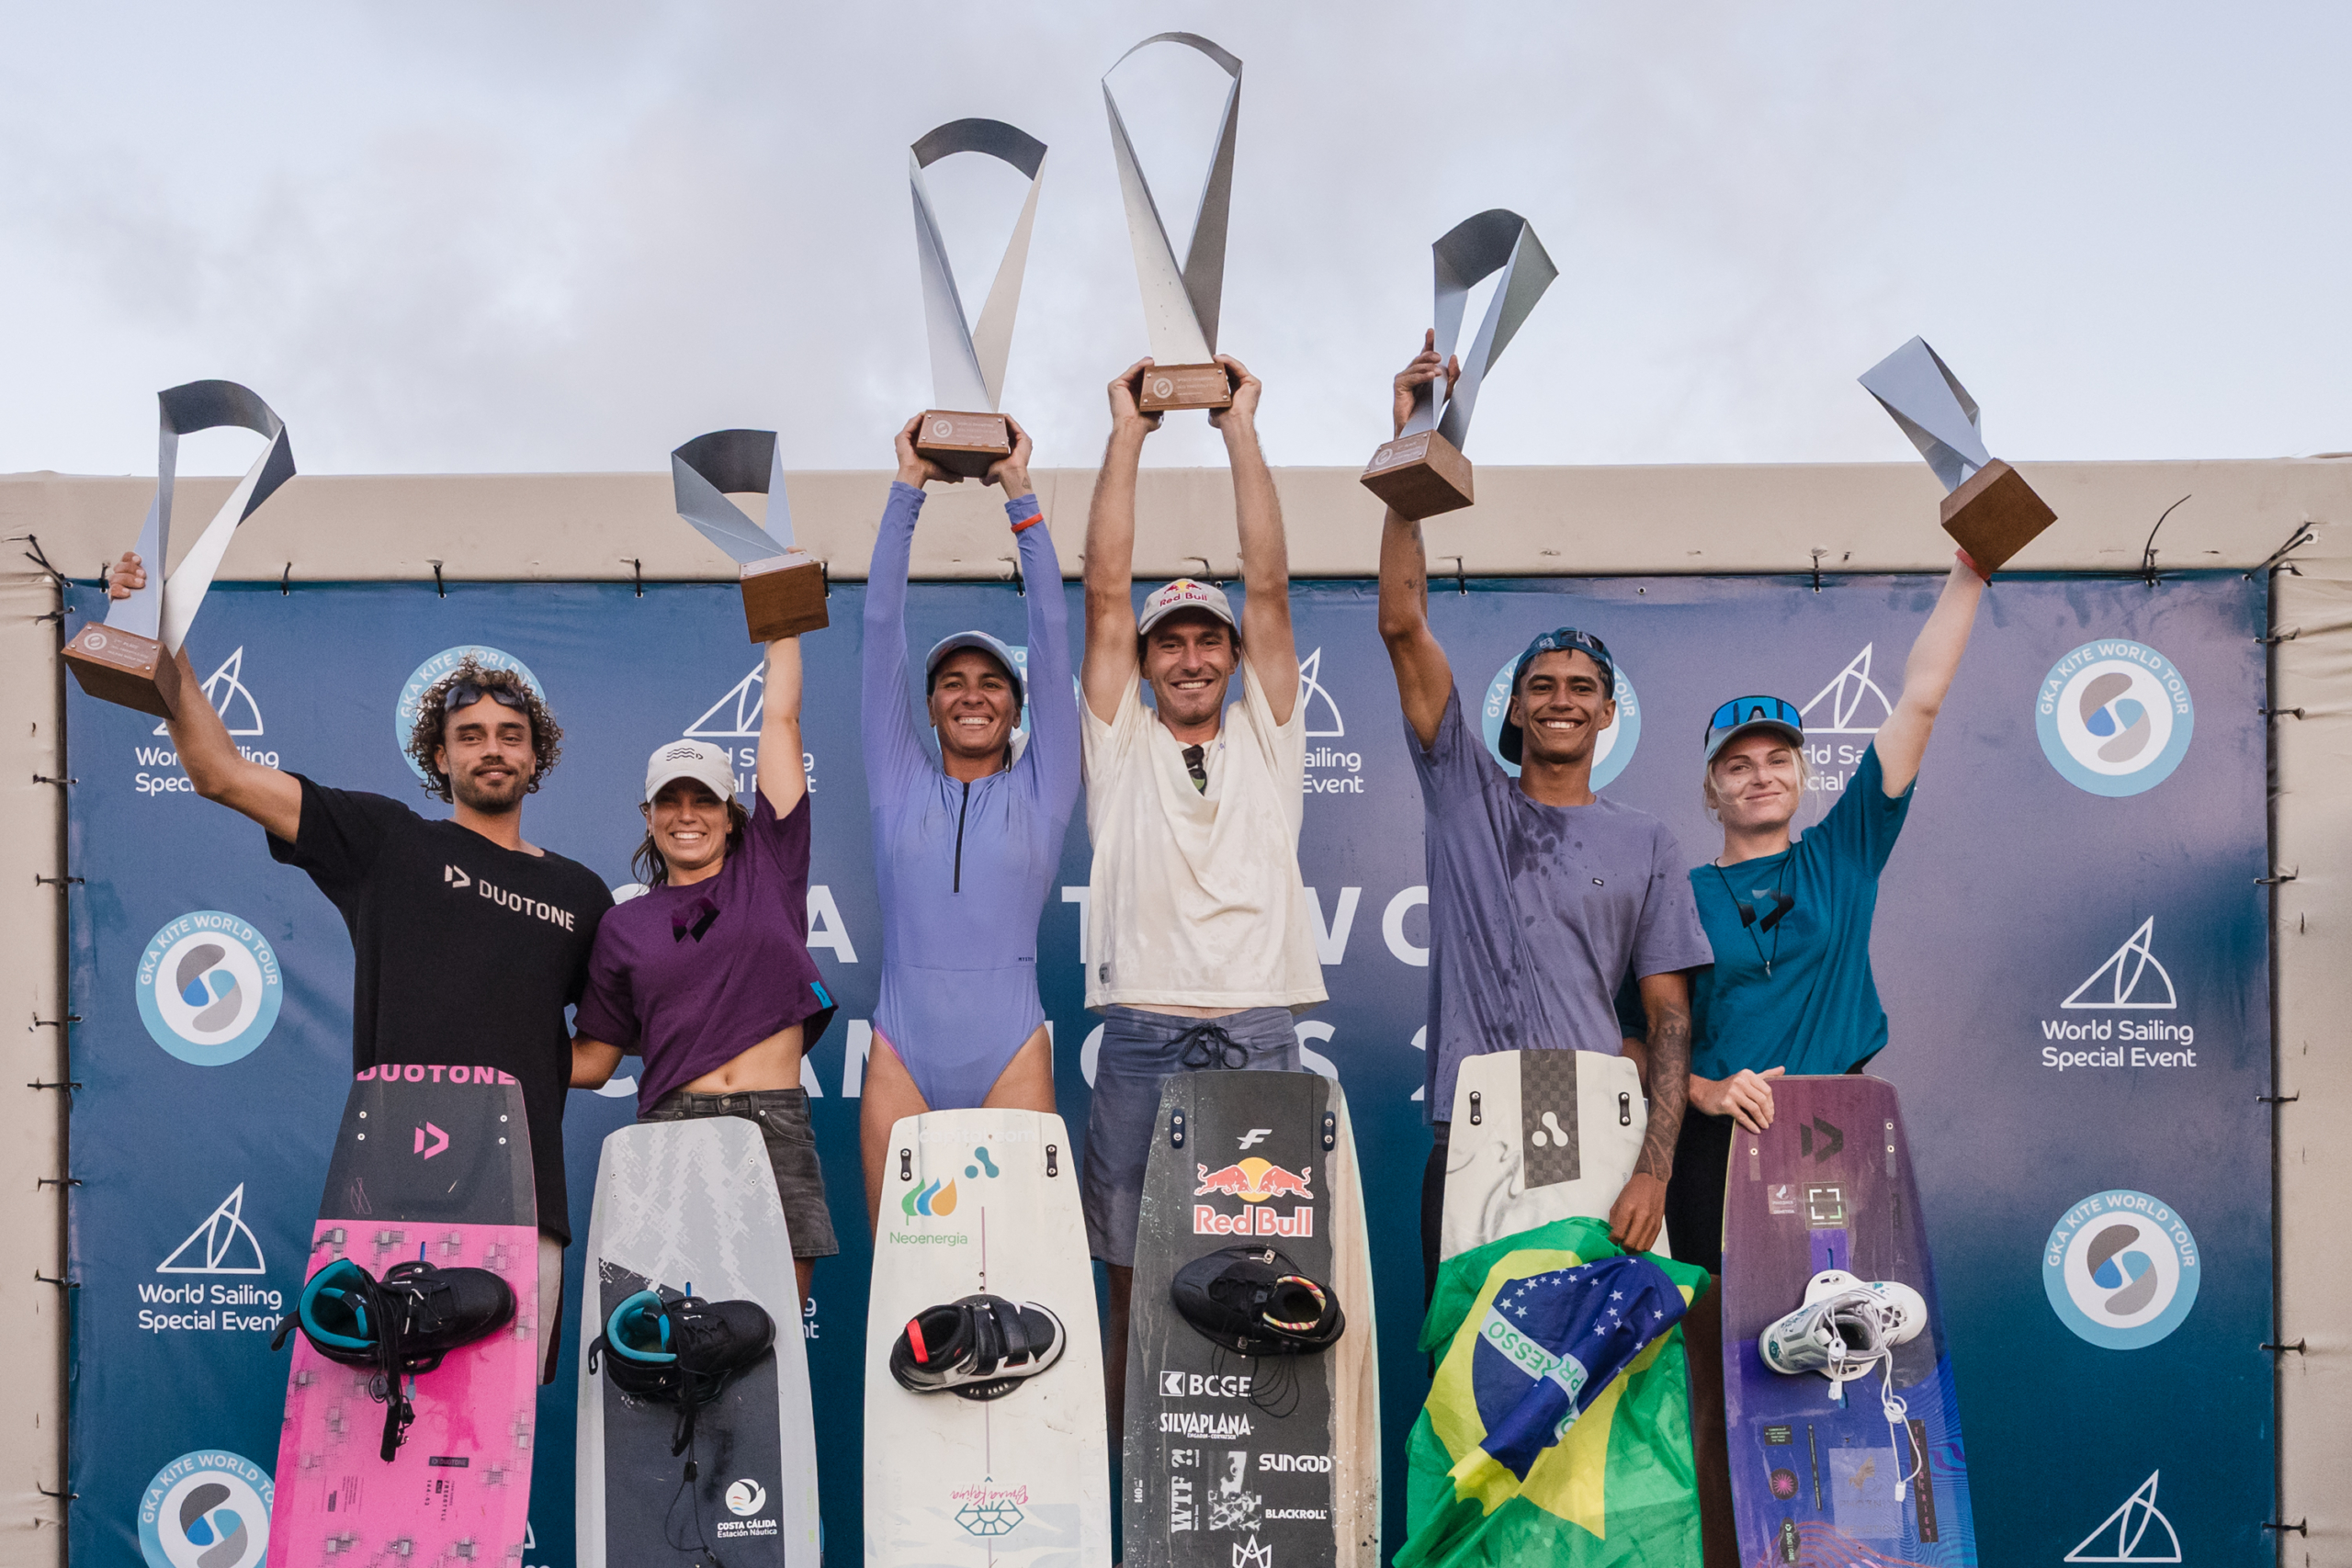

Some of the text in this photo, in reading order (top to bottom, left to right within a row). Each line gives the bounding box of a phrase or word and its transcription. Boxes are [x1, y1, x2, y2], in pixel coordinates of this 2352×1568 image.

[1159, 592, 1207, 606] Red Bull
[401, 683, 423, 718] GKA
[419, 653, 454, 682] KITE
[2041, 643, 2189, 715] GKA KITE WORLD TOUR
[1487, 682, 1510, 718] GKA
[135, 747, 178, 766] Wor
[1305, 747, 1362, 773] ailing
[479, 878, 575, 932] DUOTONE
[140, 915, 278, 986] GKA KITE WORLD TOUR
[2041, 1019, 2194, 1045] World Sailing
[2041, 1046, 2197, 1072] Special Event
[356, 1064, 516, 1085] DUOTONE
[1194, 1205, 1312, 1236] Red Bull
[2048, 1194, 2195, 1268] GKA KITE WORLD TOUR
[889, 1232, 968, 1247] Neoenergia
[138, 1283, 283, 1310] World Sailing
[138, 1309, 216, 1334] Special
[1189, 1374, 1252, 1398] BCGE
[1159, 1412, 1252, 1436] SILVAPLANA
[1259, 1453, 1332, 1472] SUNGOD
[142, 1454, 275, 1524] GKA KITE WORLD TO
[1170, 1476, 1193, 1533] WTF
[1265, 1509, 1326, 1519] BLACKROLL
[717, 1518, 777, 1531] COSTA CÁLIDA
[717, 1528, 778, 1539] Estación Náutica
